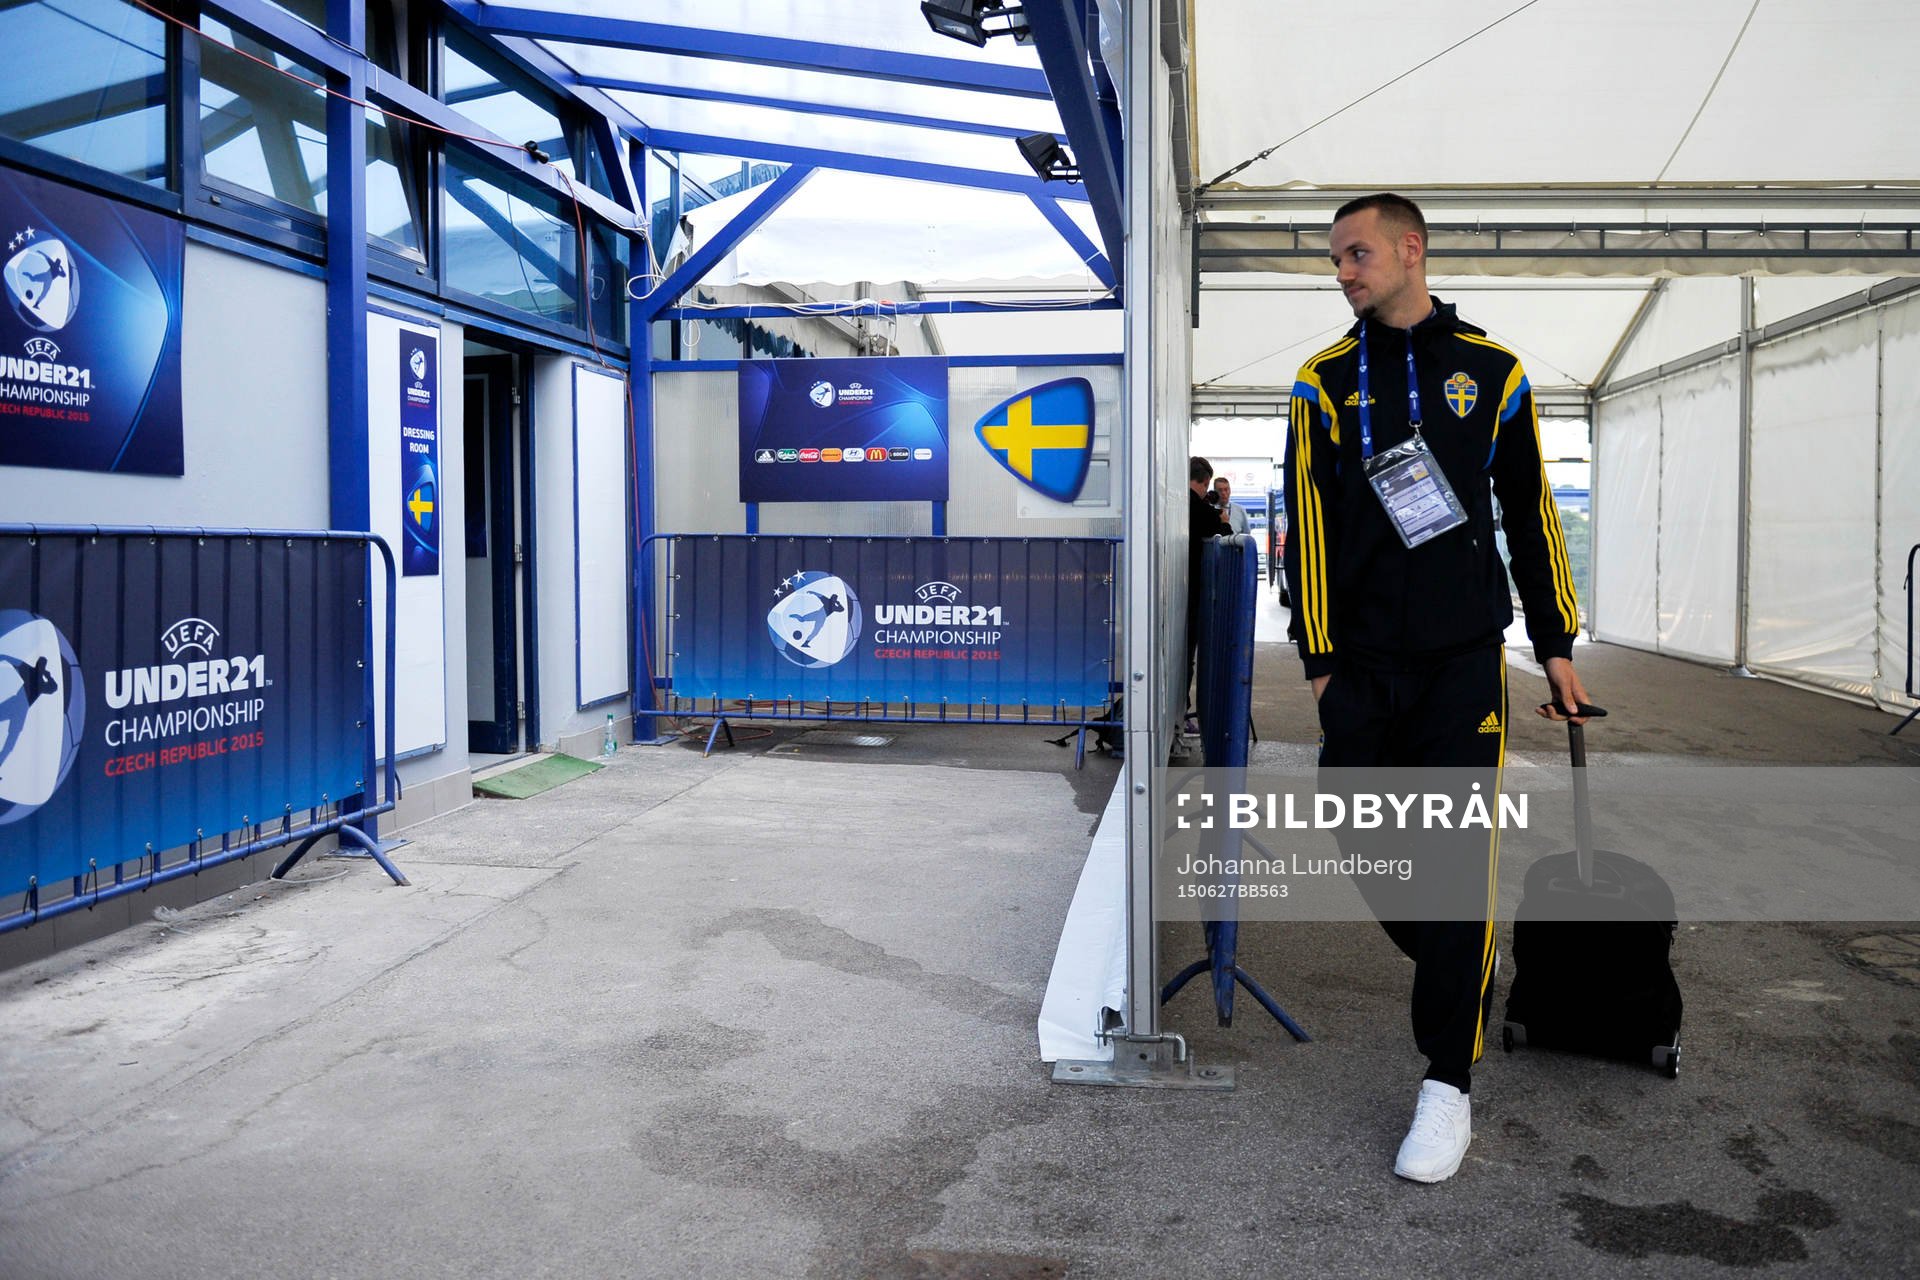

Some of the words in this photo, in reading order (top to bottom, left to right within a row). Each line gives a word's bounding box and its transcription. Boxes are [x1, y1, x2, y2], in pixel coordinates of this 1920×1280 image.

[26, 341, 57, 359] UEFA
[0, 383, 90, 407] HAMPIONSHIP
[0, 403, 20, 415] ECH
[23, 405, 65, 420] REPUBLIC
[67, 410, 90, 422] 2015
[403, 427, 435, 441] DRESSING
[409, 442, 429, 453] ROOM
[917, 584, 958, 601] UEFA
[875, 605, 1002, 626] UNDER21
[164, 624, 215, 653] UEFA
[874, 630, 1001, 645] CHAMPIONSHIP
[874, 648, 911, 659] CZECH
[914, 649, 969, 660] REPUBLIC
[971, 650, 1001, 661] 2015
[105, 654, 265, 709] UNDER21
[105, 698, 265, 747] CHAMPIONSHIP
[104, 751, 156, 777] CZECH
[159, 737, 228, 766] REPUBLIC
[231, 731, 265, 752] 2015
